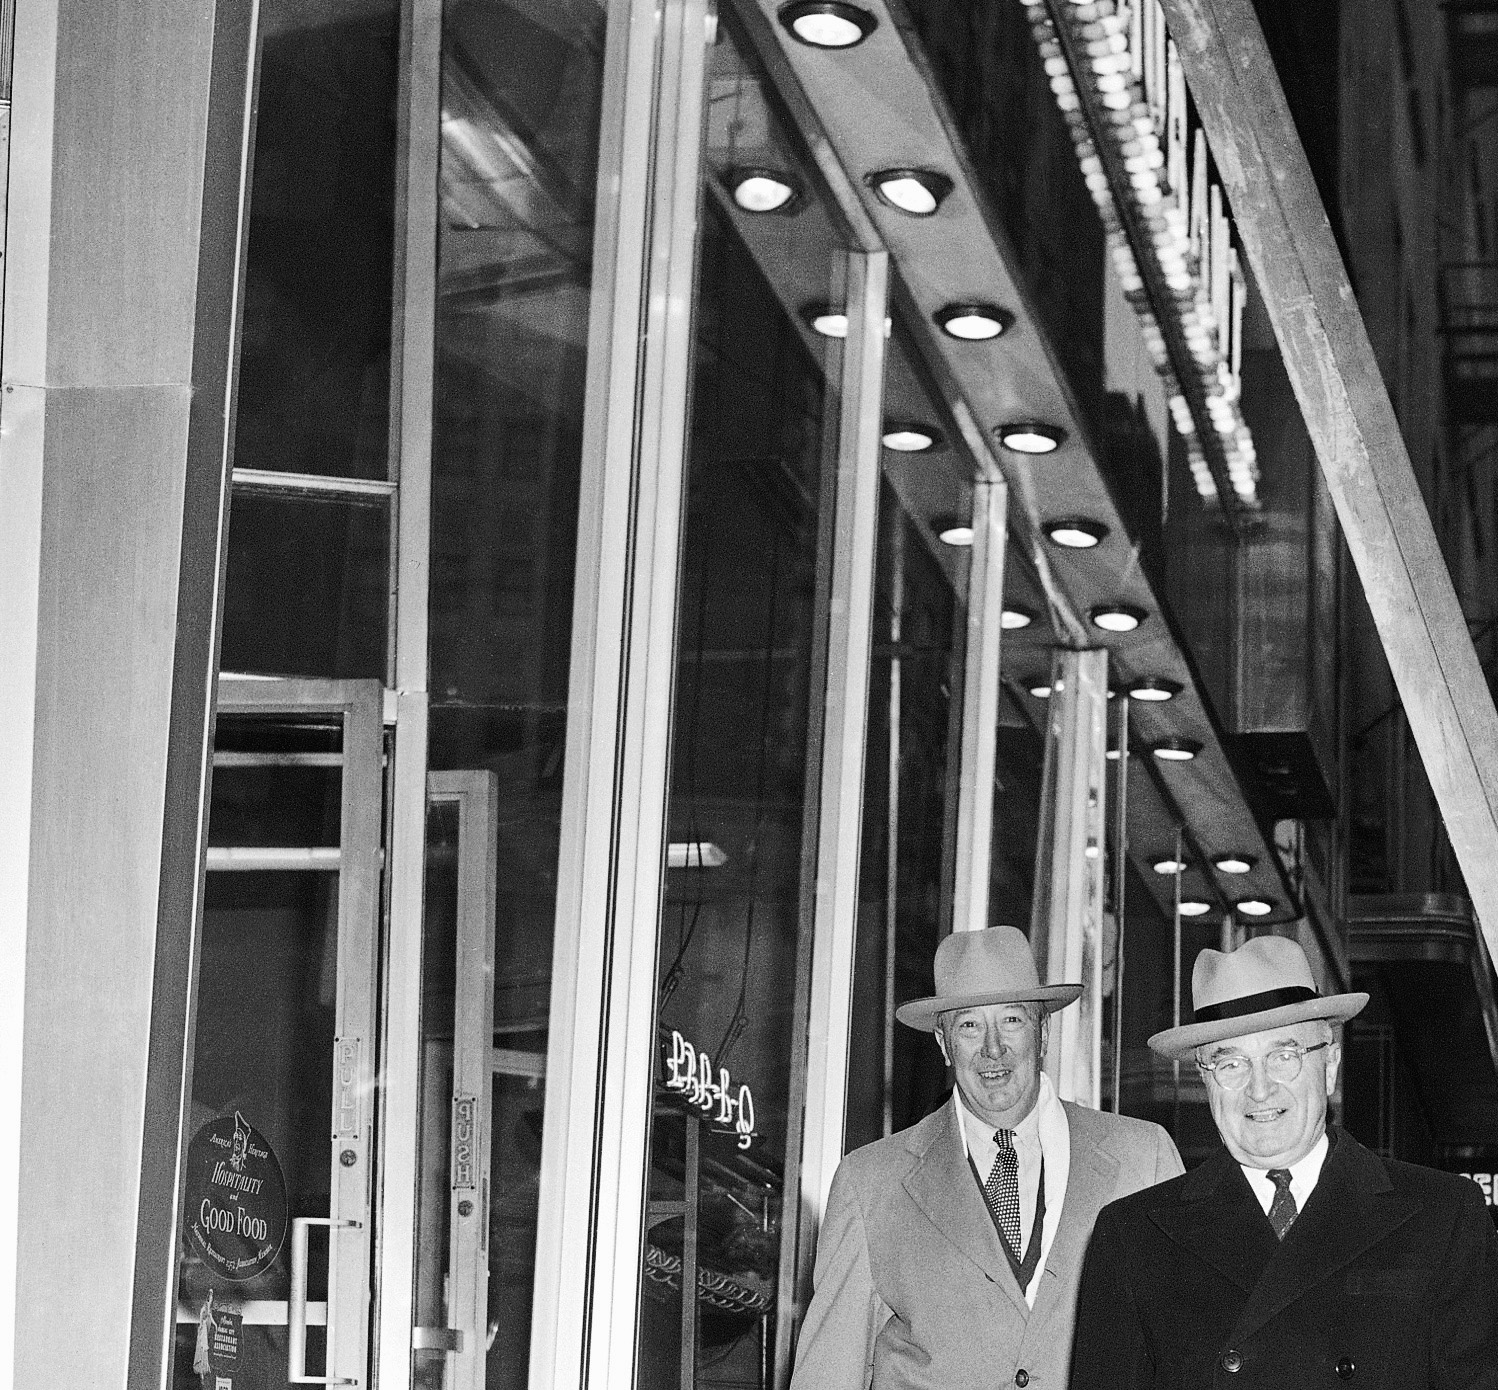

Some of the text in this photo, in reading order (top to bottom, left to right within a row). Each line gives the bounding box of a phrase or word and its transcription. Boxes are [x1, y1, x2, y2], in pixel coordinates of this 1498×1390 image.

[340, 1044, 354, 1131] PULL
[211, 1160, 264, 1195] HOSPITALITY
[200, 1198, 267, 1241] GOOD FOOD
